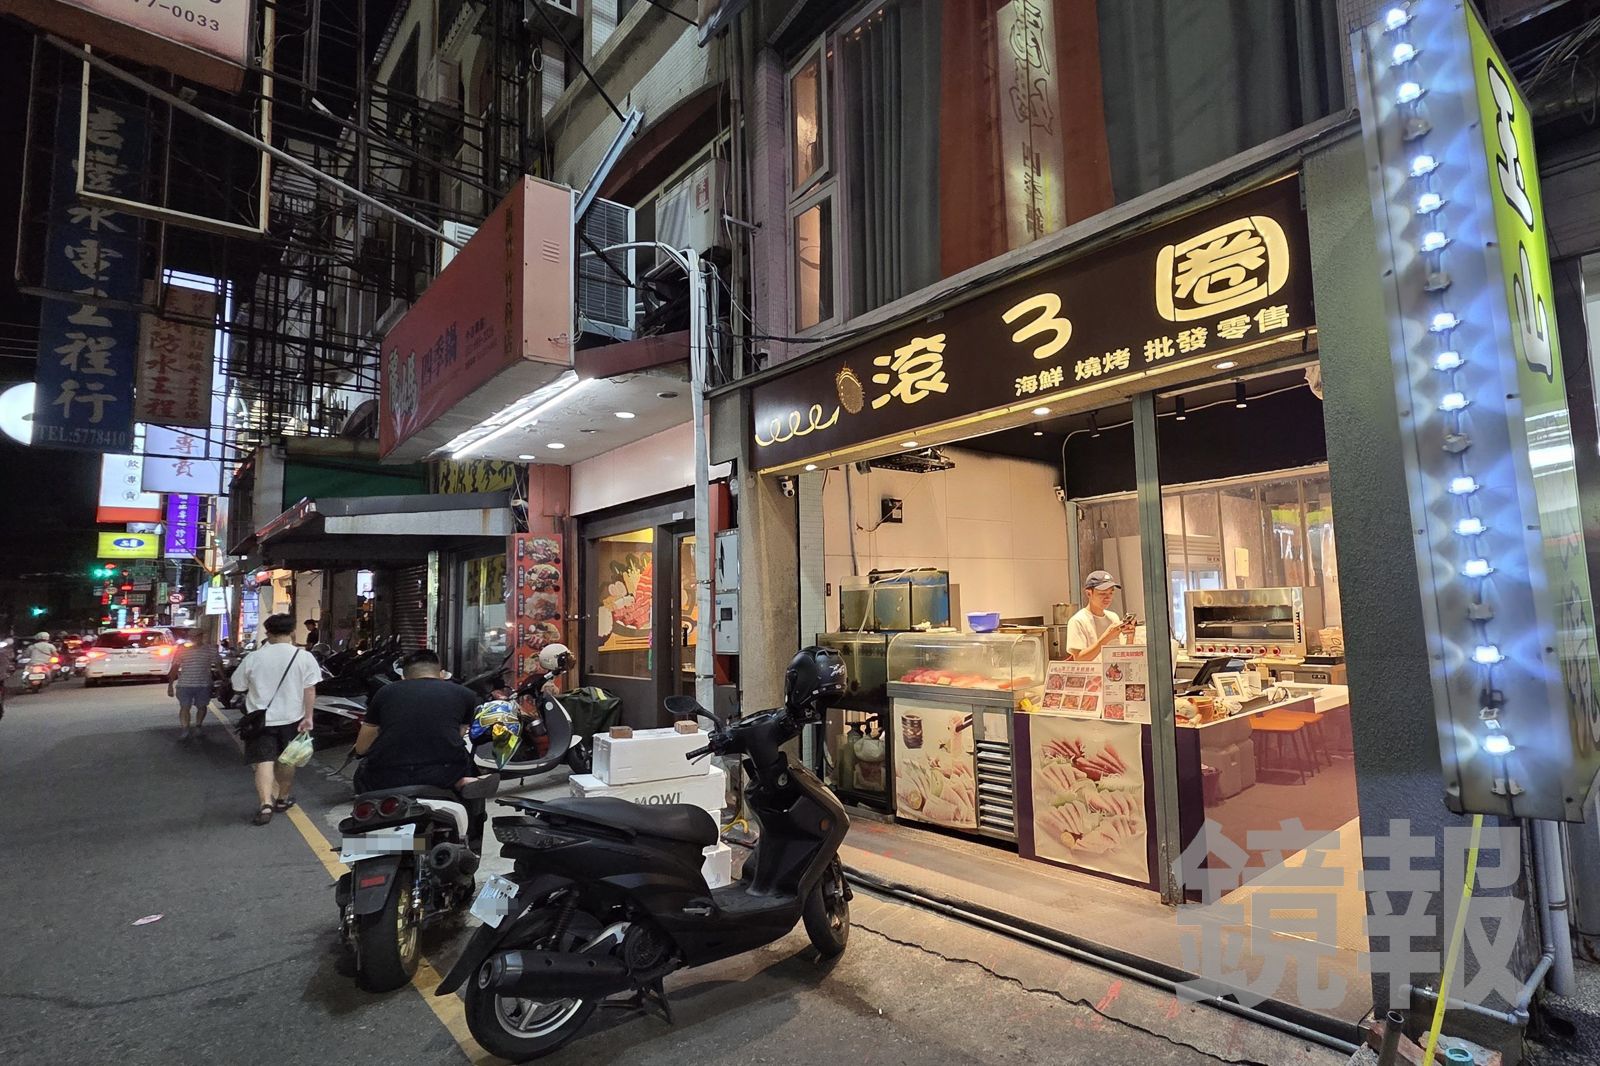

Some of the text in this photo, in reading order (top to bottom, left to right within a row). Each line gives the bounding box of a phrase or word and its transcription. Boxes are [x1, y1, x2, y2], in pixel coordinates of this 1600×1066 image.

[134, 0, 220, 32] 7-0033
[1014, 304, 1290, 397] 海鮮 燒烤 批發 零售
[634, 791, 682, 805] MOWI
